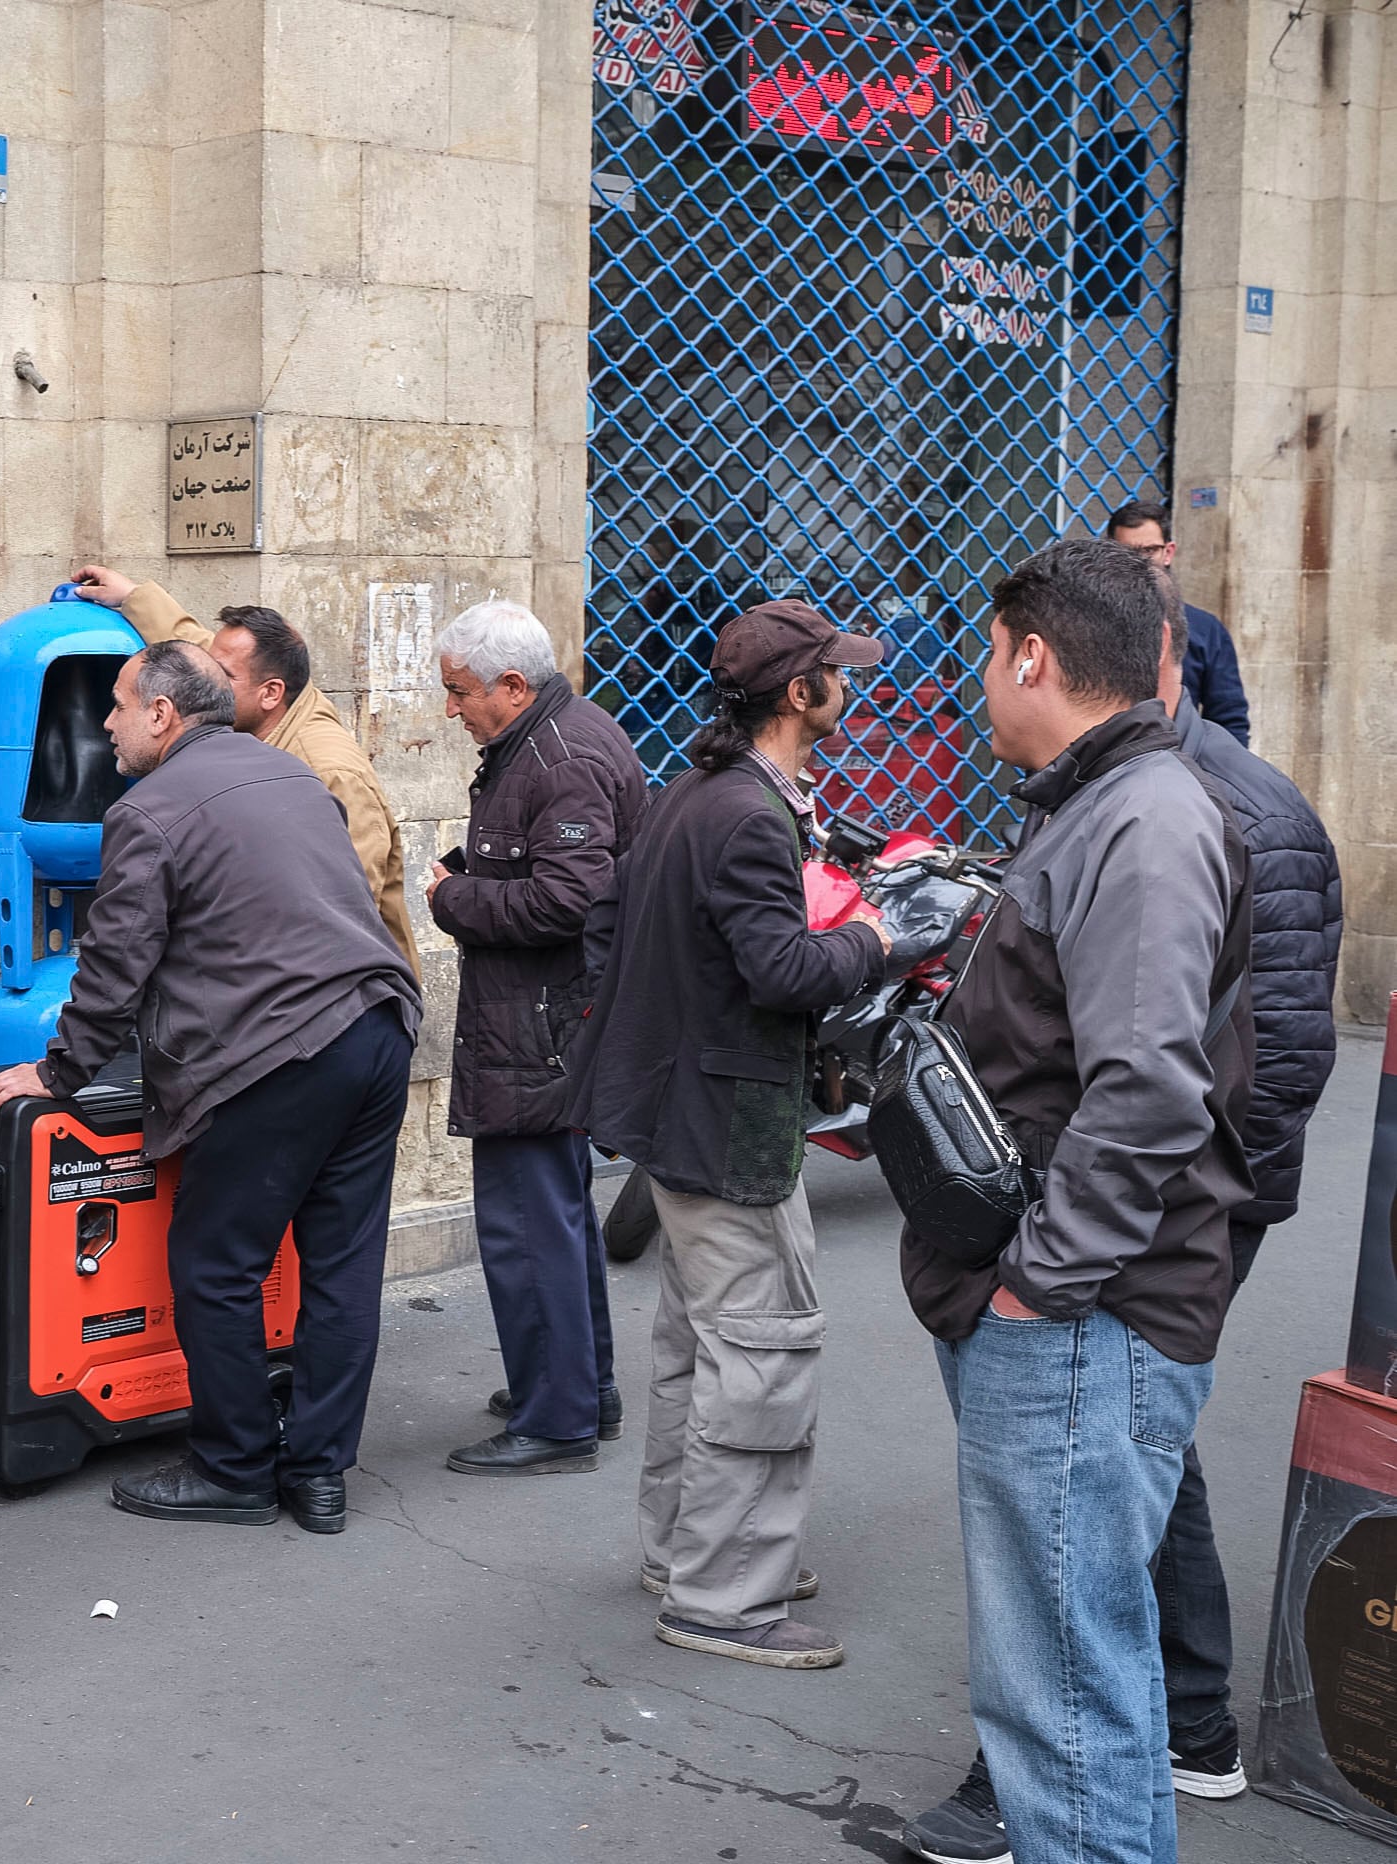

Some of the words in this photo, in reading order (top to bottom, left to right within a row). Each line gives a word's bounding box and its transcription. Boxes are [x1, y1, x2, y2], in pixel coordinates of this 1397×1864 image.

[173, 431, 210, 461] آرمان
[212, 431, 251, 457] شرکت
[172, 477, 207, 502] جهان
[211, 476, 251, 494] صنعت
[186, 522, 208, 539] ۳۱۲
[210, 520, 235, 541] پلاک
[61, 1161, 102, 1176] Calmo
